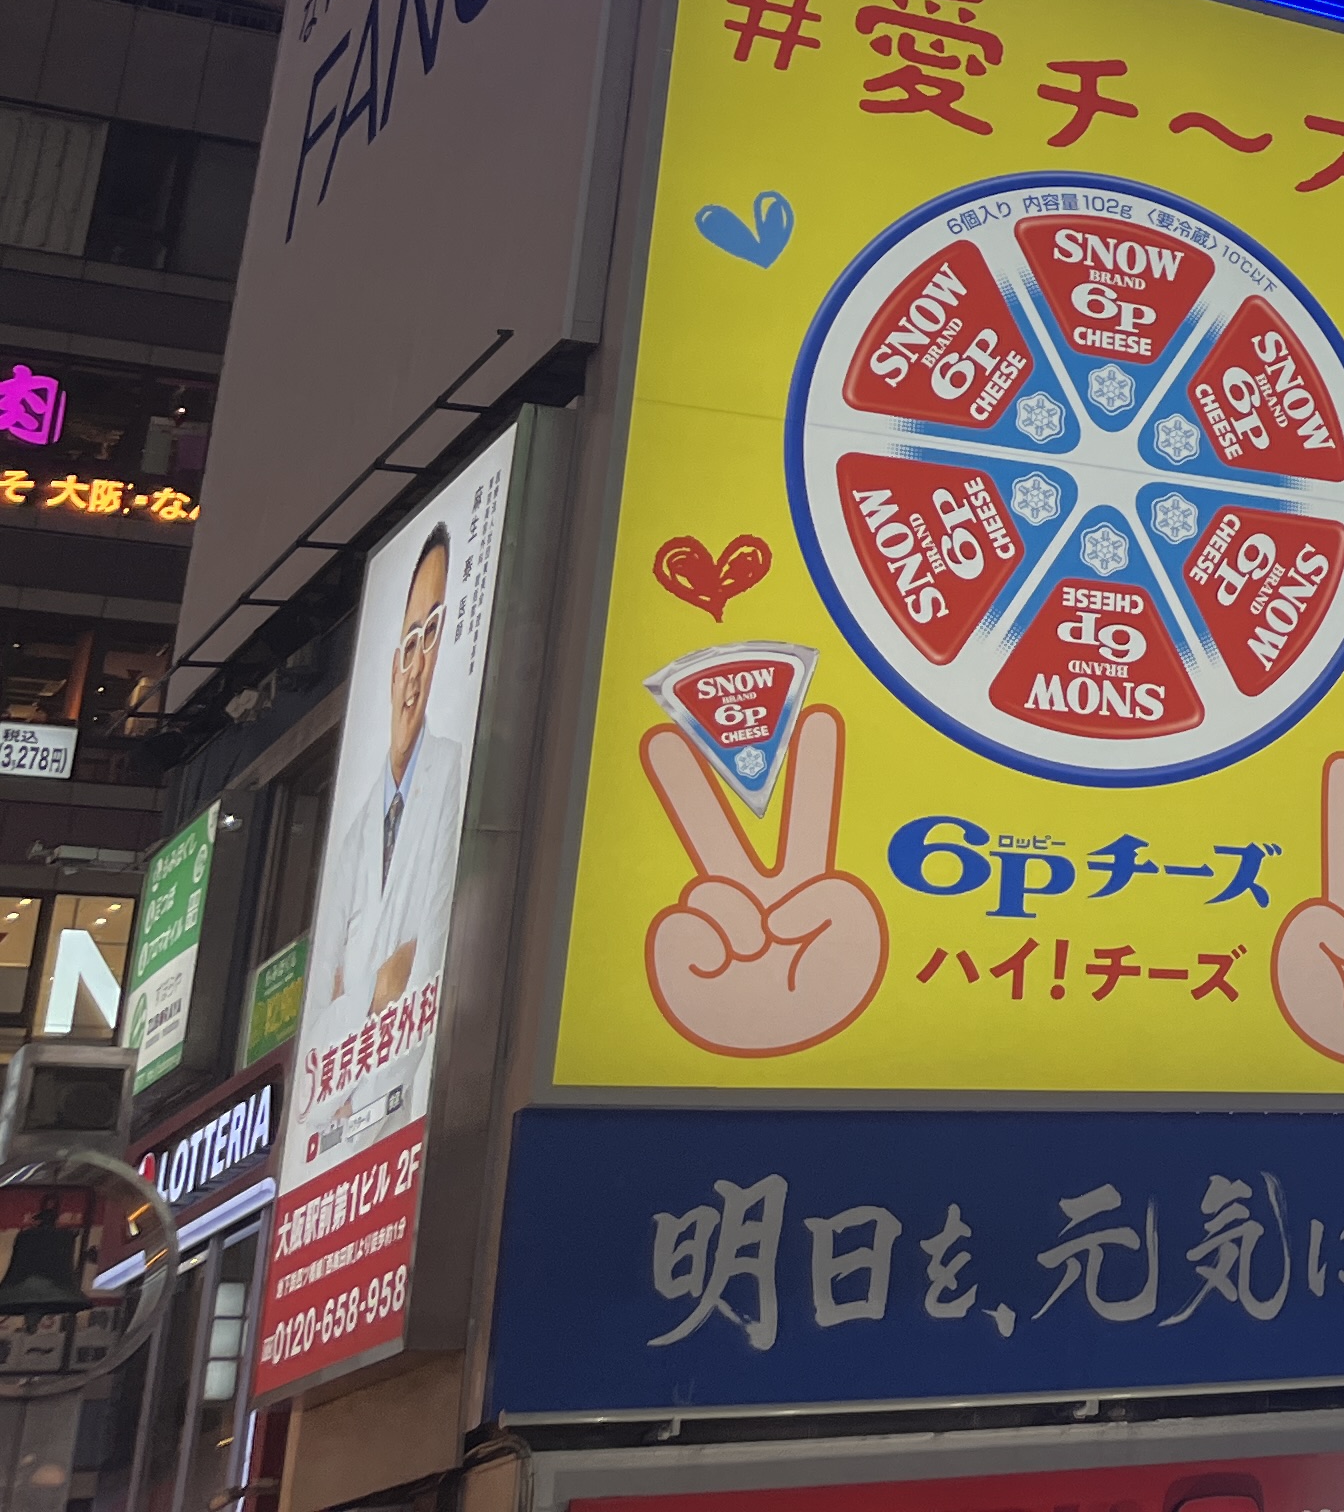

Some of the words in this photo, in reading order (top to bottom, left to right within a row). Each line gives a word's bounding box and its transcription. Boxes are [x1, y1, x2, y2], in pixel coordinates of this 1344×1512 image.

[947, 200, 1012, 235] 6個入り
[1023, 193, 1133, 219] 内容量102g
[1053, 229, 1185, 281] SNOW
[1089, 269, 1146, 290] BRAND
[869, 263, 968, 388] SNOW
[920, 317, 963, 369] BRAND
[1073, 326, 1152, 356] CHEESE
[969, 350, 1027, 421] CHEESE
[1251, 331, 1336, 450] SNOW
[1255, 374, 1288, 428] BRAND
[1195, 383, 1243, 461] CHEESE
[46, 474, 200, 522] 大阪・な
[963, 476, 1016, 560] CHEESE
[853, 489, 949, 624] SNOW
[909, 513, 947, 575] BRAND
[1188, 513, 1241, 585] CHEESE
[1062, 587, 1144, 614] CHEESE
[1247, 542, 1330, 672] SNOW
[1250, 562, 1285, 615] BRAND
[697, 667, 775, 699] SNOW
[1068, 660, 1128, 678] BRAND
[1024, 673, 1166, 721] SNOW
[3, 728, 38, 744] 税込
[721, 725, 769, 744] CHEESE
[998, 834, 1066, 850] ロッピー
[916, 937, 1247, 1002] ハイ!チーズ
[316, 975, 439, 1103] 東京美容外科
[157, 1084, 271, 1203] LOTTERIA
[395, 1142, 421, 1189] 2F
[272, 1264, 407, 1364] 0120-658-958
